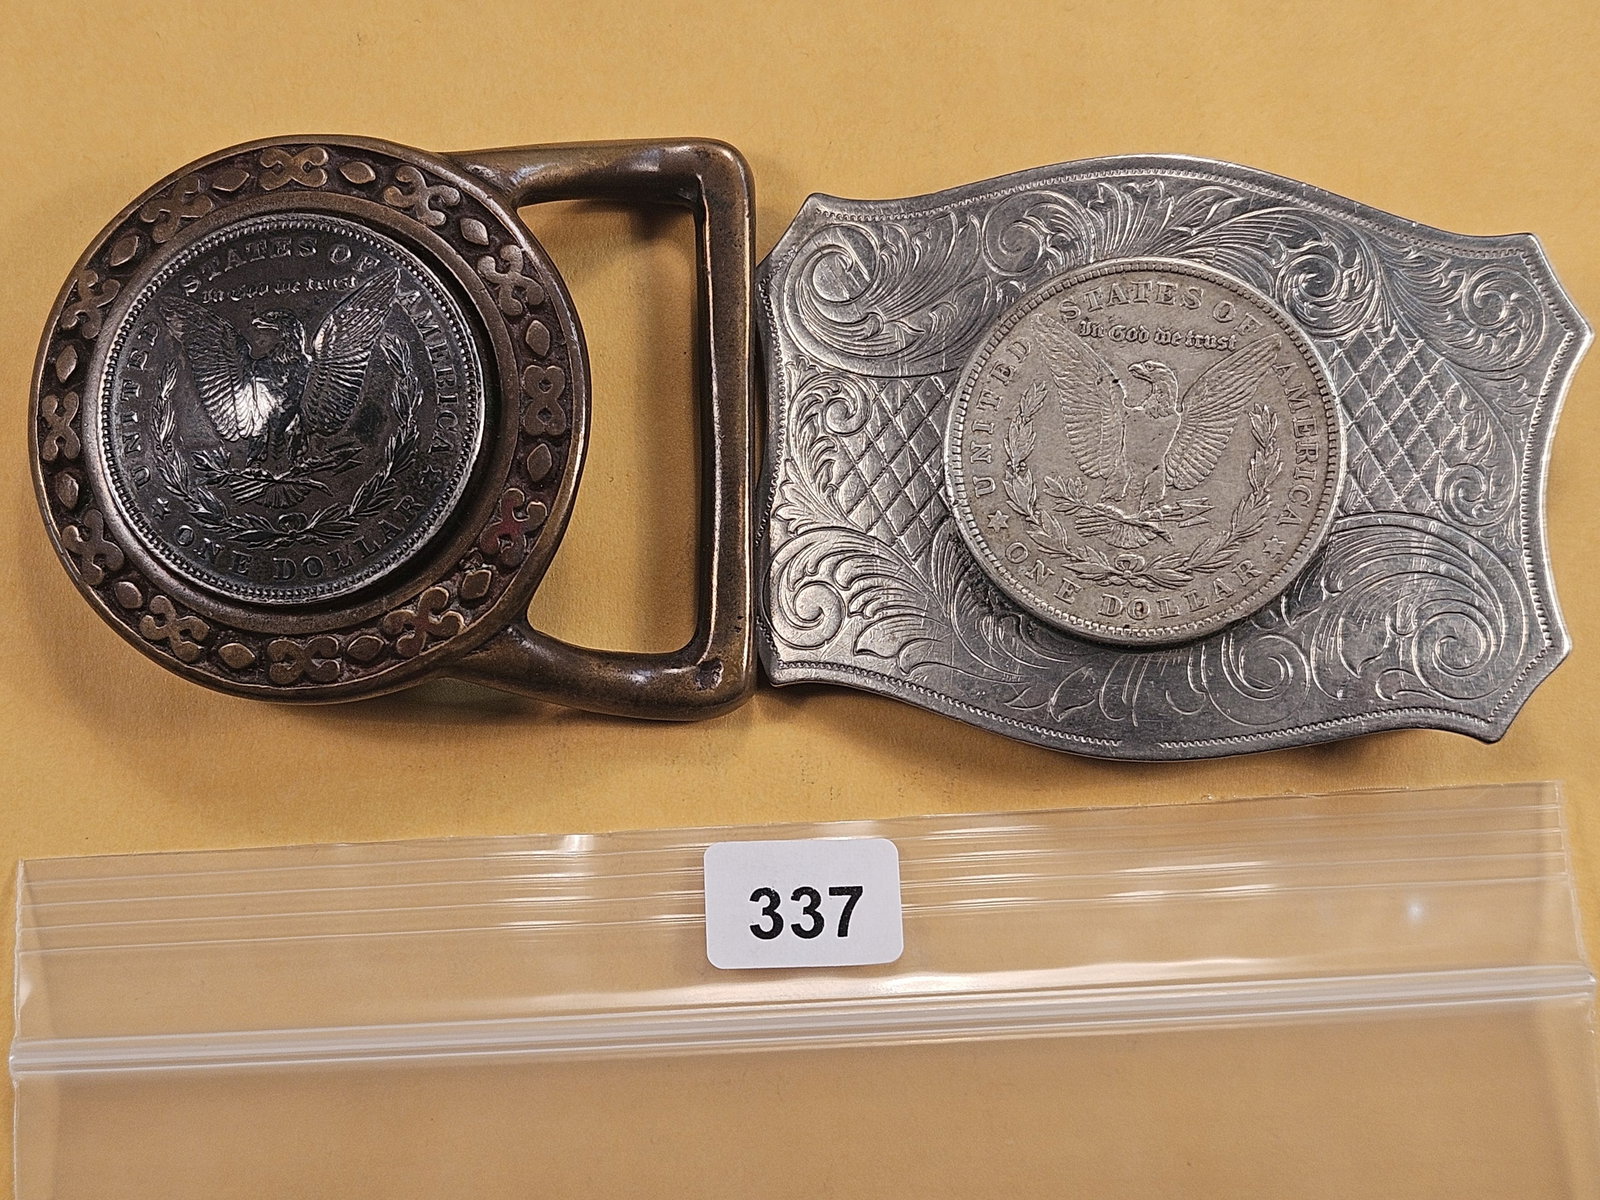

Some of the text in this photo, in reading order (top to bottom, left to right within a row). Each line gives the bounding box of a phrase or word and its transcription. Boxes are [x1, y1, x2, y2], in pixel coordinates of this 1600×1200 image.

[123, 236, 460, 491] UNITED STATES OF AMERICA
[1106, 324, 1151, 343] God
[1153, 328, 1182, 345] we
[1184, 330, 1238, 352] trust
[969, 280, 1320, 528] UNITED STATES OF AMERICA
[177, 493, 426, 581] ONE DOLLAR
[1005, 540, 1263, 620] ONE DOLLAR
[749, 885, 863, 940] 337
